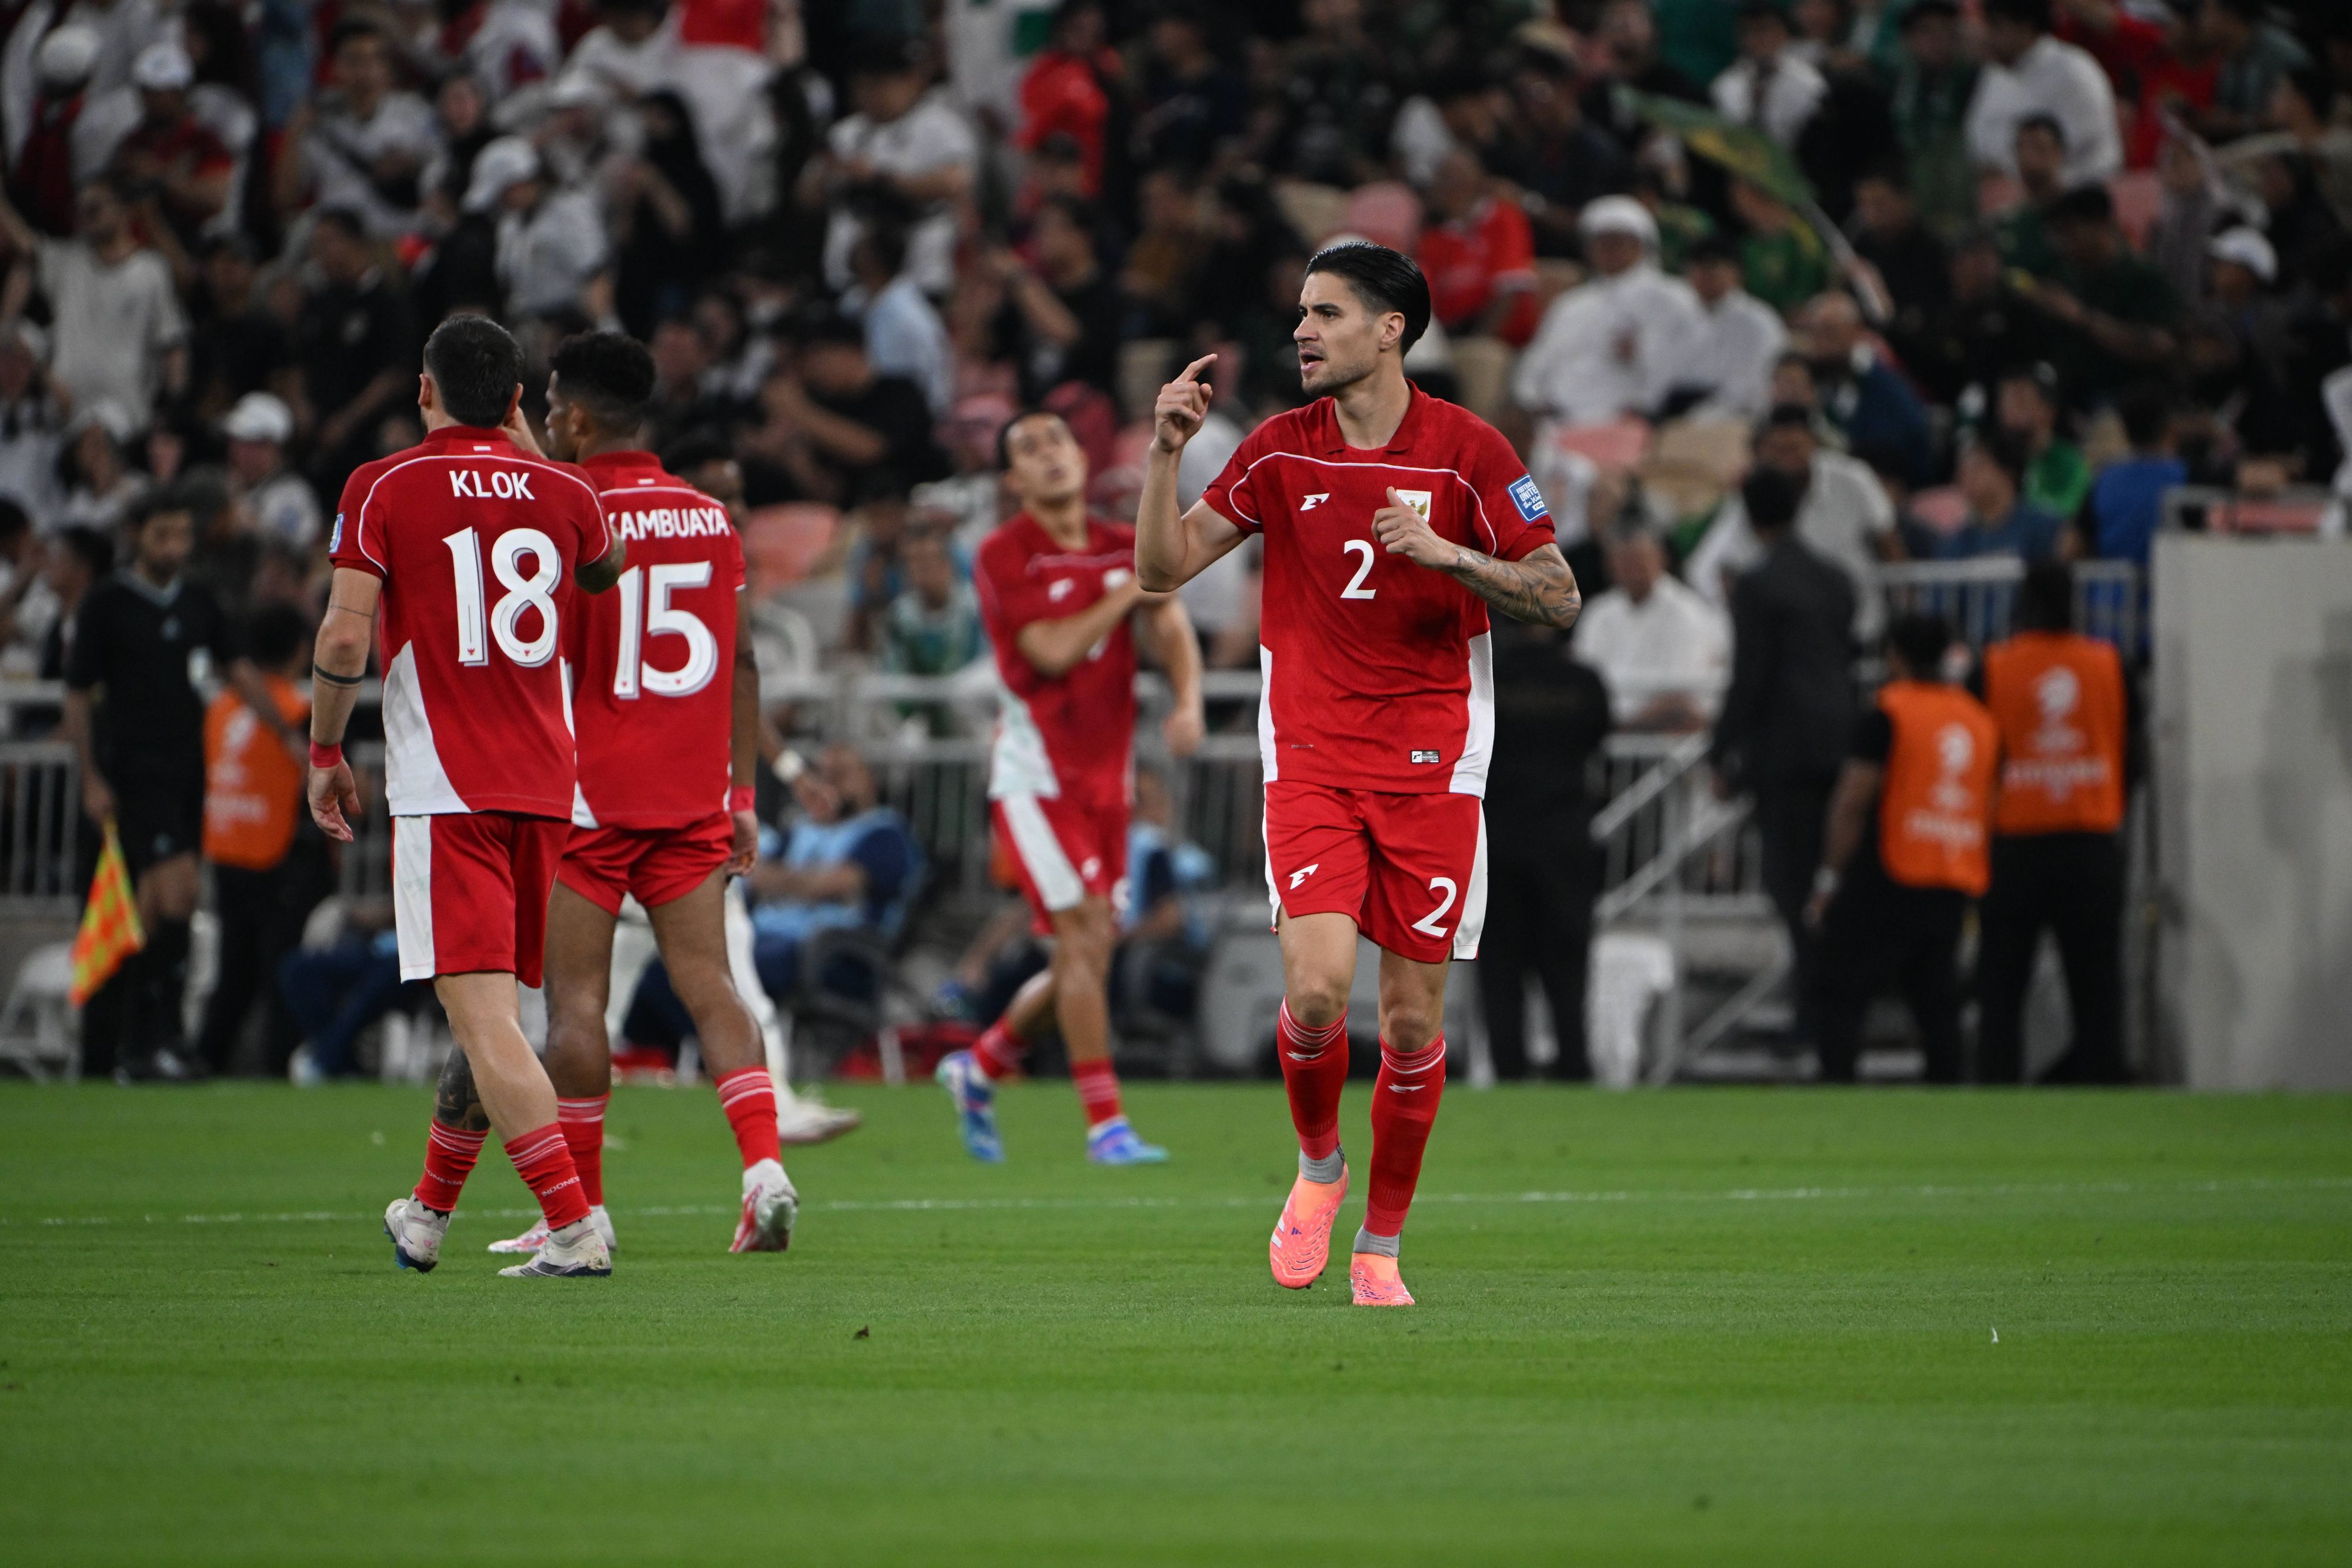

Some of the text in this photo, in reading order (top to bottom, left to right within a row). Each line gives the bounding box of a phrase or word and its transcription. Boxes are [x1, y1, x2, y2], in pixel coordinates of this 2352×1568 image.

[449, 470, 534, 500] KLOK
[442, 526, 562, 667] 18
[1340, 539, 1377, 599] 2
[613, 560, 719, 700] 15
[1412, 877, 1456, 938] 2
